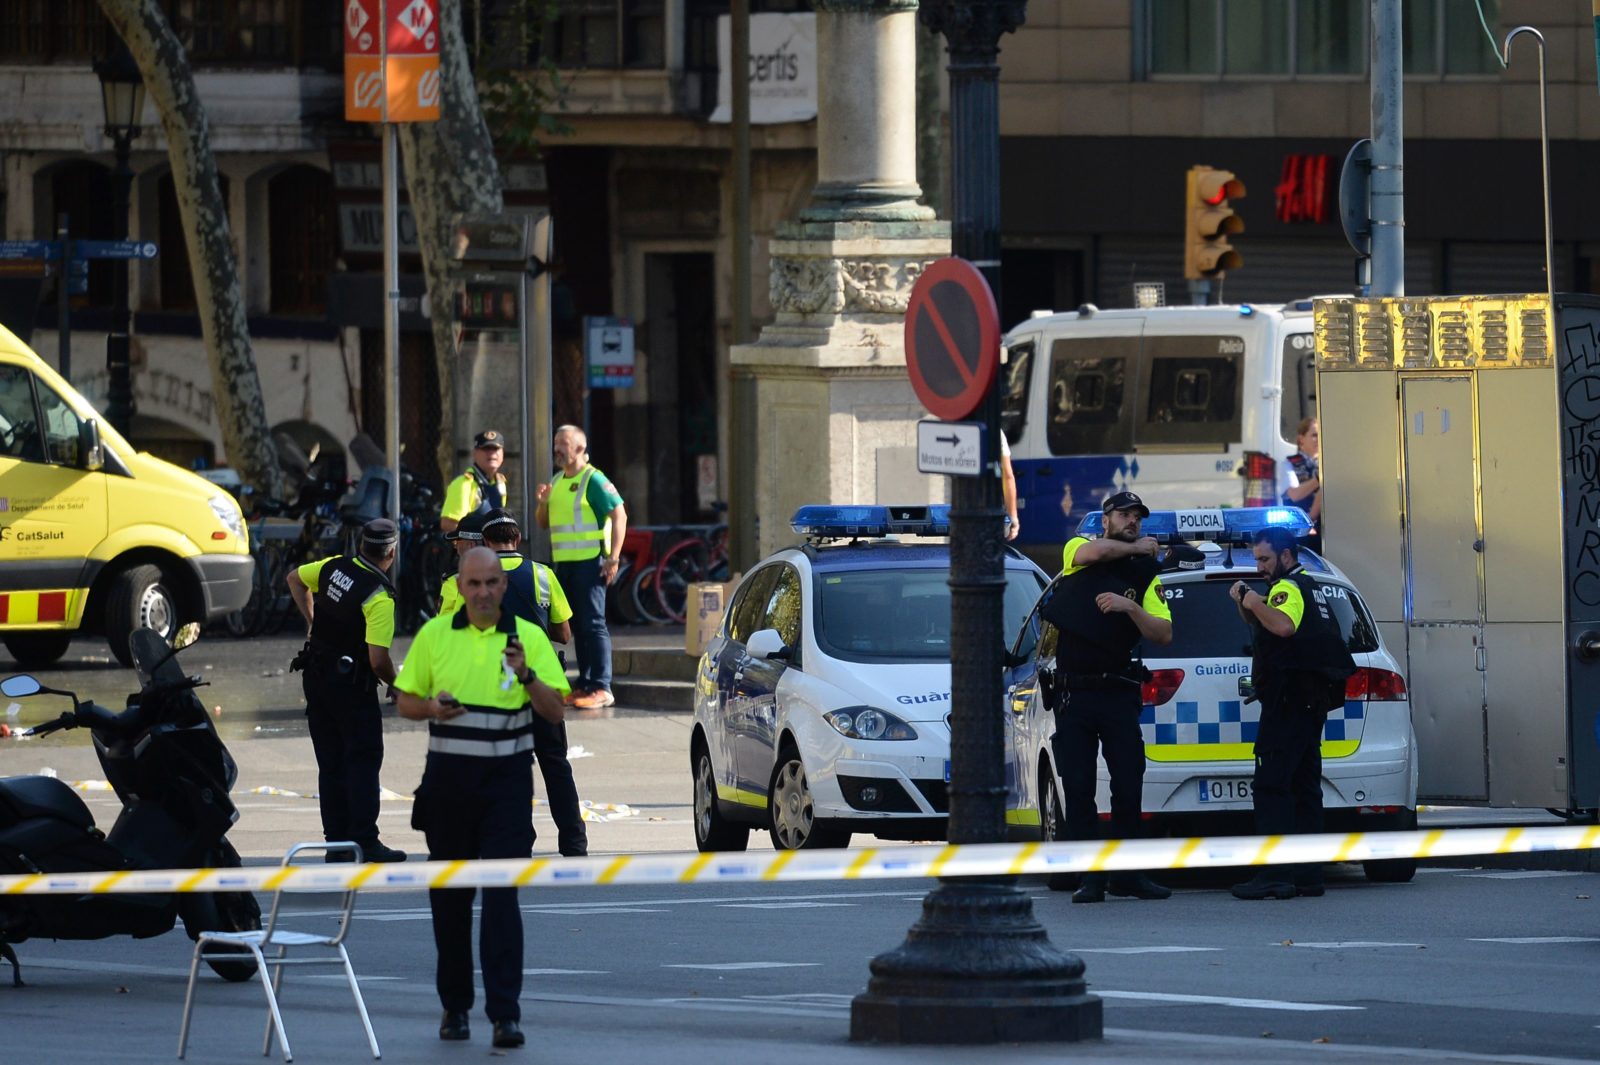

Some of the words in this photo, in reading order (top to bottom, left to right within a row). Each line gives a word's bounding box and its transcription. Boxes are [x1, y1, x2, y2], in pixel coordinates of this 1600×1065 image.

[411, 8, 425, 28] M
[1180, 514, 1220, 528] POLICIA
[17, 531, 64, 541] CatSalut
[329, 569, 354, 592] POLICIA
[1195, 663, 1248, 677] Guàrdia
